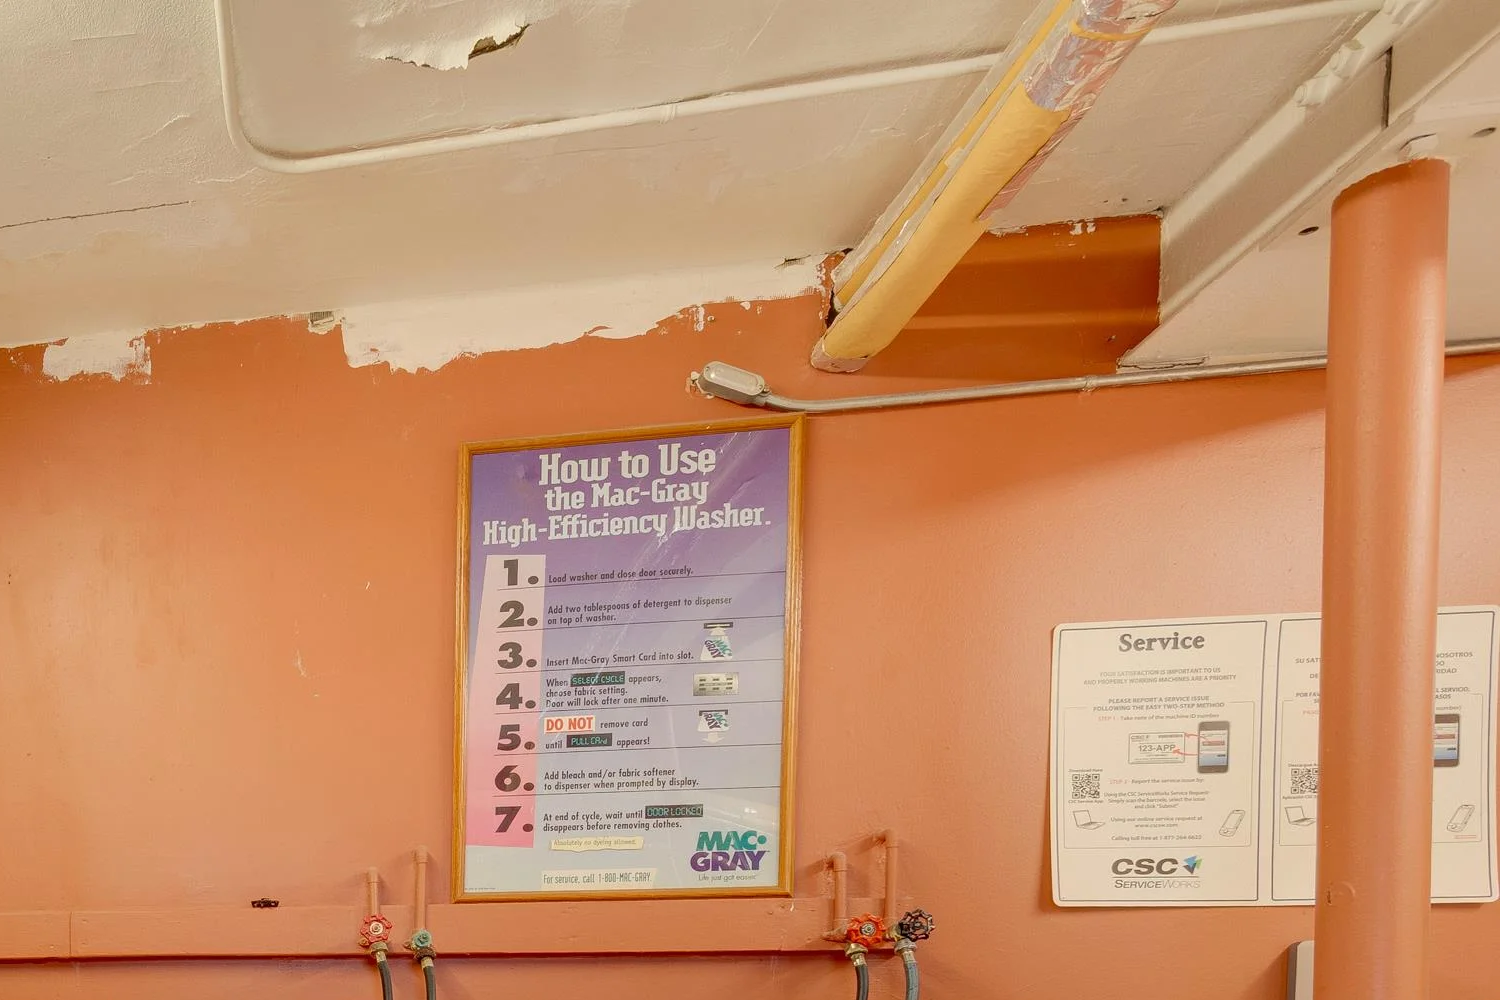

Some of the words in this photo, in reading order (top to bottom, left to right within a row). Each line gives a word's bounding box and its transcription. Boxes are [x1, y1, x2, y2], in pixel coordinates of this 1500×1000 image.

[539, 453, 611, 486] How
[618, 450, 649, 479] to
[659, 443, 716, 475] Use
[545, 488, 585, 512] the
[591, 478, 709, 509] Mac-Gray
[483, 514, 668, 548] High-Efficiency
[672, 503, 771, 532] Washer.
[503, 559, 539, 586] 1.
[548, 574, 567, 584] Load
[569, 573, 598, 582] washer
[600, 571, 615, 580] and
[617, 569, 636, 579] close
[638, 568, 657, 578] door
[659, 565, 694, 577] securely.
[497, 600, 539, 629] 2.
[548, 605, 563, 615] Add
[565, 604, 581, 614] two
[583, 602, 630, 615] tablespoons
[632, 600, 642, 609] of
[643, 599, 681, 611] detergent
[683, 598, 692, 607] to
[694, 596, 733, 608] dispenser
[547, 617, 557, 625] on
[559, 615, 573, 626] top
[575, 614, 584, 624] of
[586, 613, 616, 623] washer.
[497, 641, 537, 669] 3.
[546, 657, 569, 667] Insert
[571, 655, 610, 666] Mac-Gray
[612, 653, 636, 663] Smart
[638, 653, 656, 662] Card
[658, 652, 674, 661] into
[676, 651, 694, 660] slot.
[1118, 632, 1205, 652] Service
[495, 683, 536, 709] 4.
[546, 678, 568, 687] When
[572, 675, 599, 685] SELECT
[601, 674, 625, 683] CYCLE
[628, 675, 662, 685] appears,
[546, 689, 572, 698] choose
[574, 687, 597, 697] fabric
[598, 686, 628, 697] setting.
[546, 699, 564, 708] Door
[567, 698, 582, 706] will
[583, 696, 599, 706] lock
[601, 695, 621, 705] after
[623, 696, 638, 704] one
[640, 694, 669, 703] minute.
[497, 724, 536, 751] 5.
[546, 719, 564, 731] DO
[568, 717, 594, 730] NOT
[600, 720, 630, 729] remove
[632, 718, 649, 727] card
[1138, 744, 1175, 752] 123-APP
[494, 765, 535, 792] 6.
[544, 771, 559, 780] Add
[562, 770, 586, 779] bleach
[588, 769, 616, 779] and/or
[618, 768, 640, 777] fabric
[643, 768, 676, 777] softener
[544, 782, 552, 791] to
[554, 781, 591, 792] dispenser
[593, 780, 615, 789] when
[617, 778, 654, 791] prompted
[656, 778, 666, 789] by
[668, 777, 699, 788] display.
[494, 806, 534, 833] 7.
[543, 813, 552, 822] At
[554, 812, 569, 821] end
[571, 811, 580, 820] of
[582, 810, 602, 823] cycle,
[605, 810, 623, 819] wait
[625, 809, 643, 818] until
[646, 807, 669, 817] DOOR
[671, 806, 703, 816] LOCKED
[543, 822, 584, 833] disappears
[586, 821, 611, 831] before
[613, 820, 650, 831] removing
[652, 820, 682, 829] clothes.
[690, 850, 766, 872] GRAY
[1111, 857, 1178, 875] CSC
